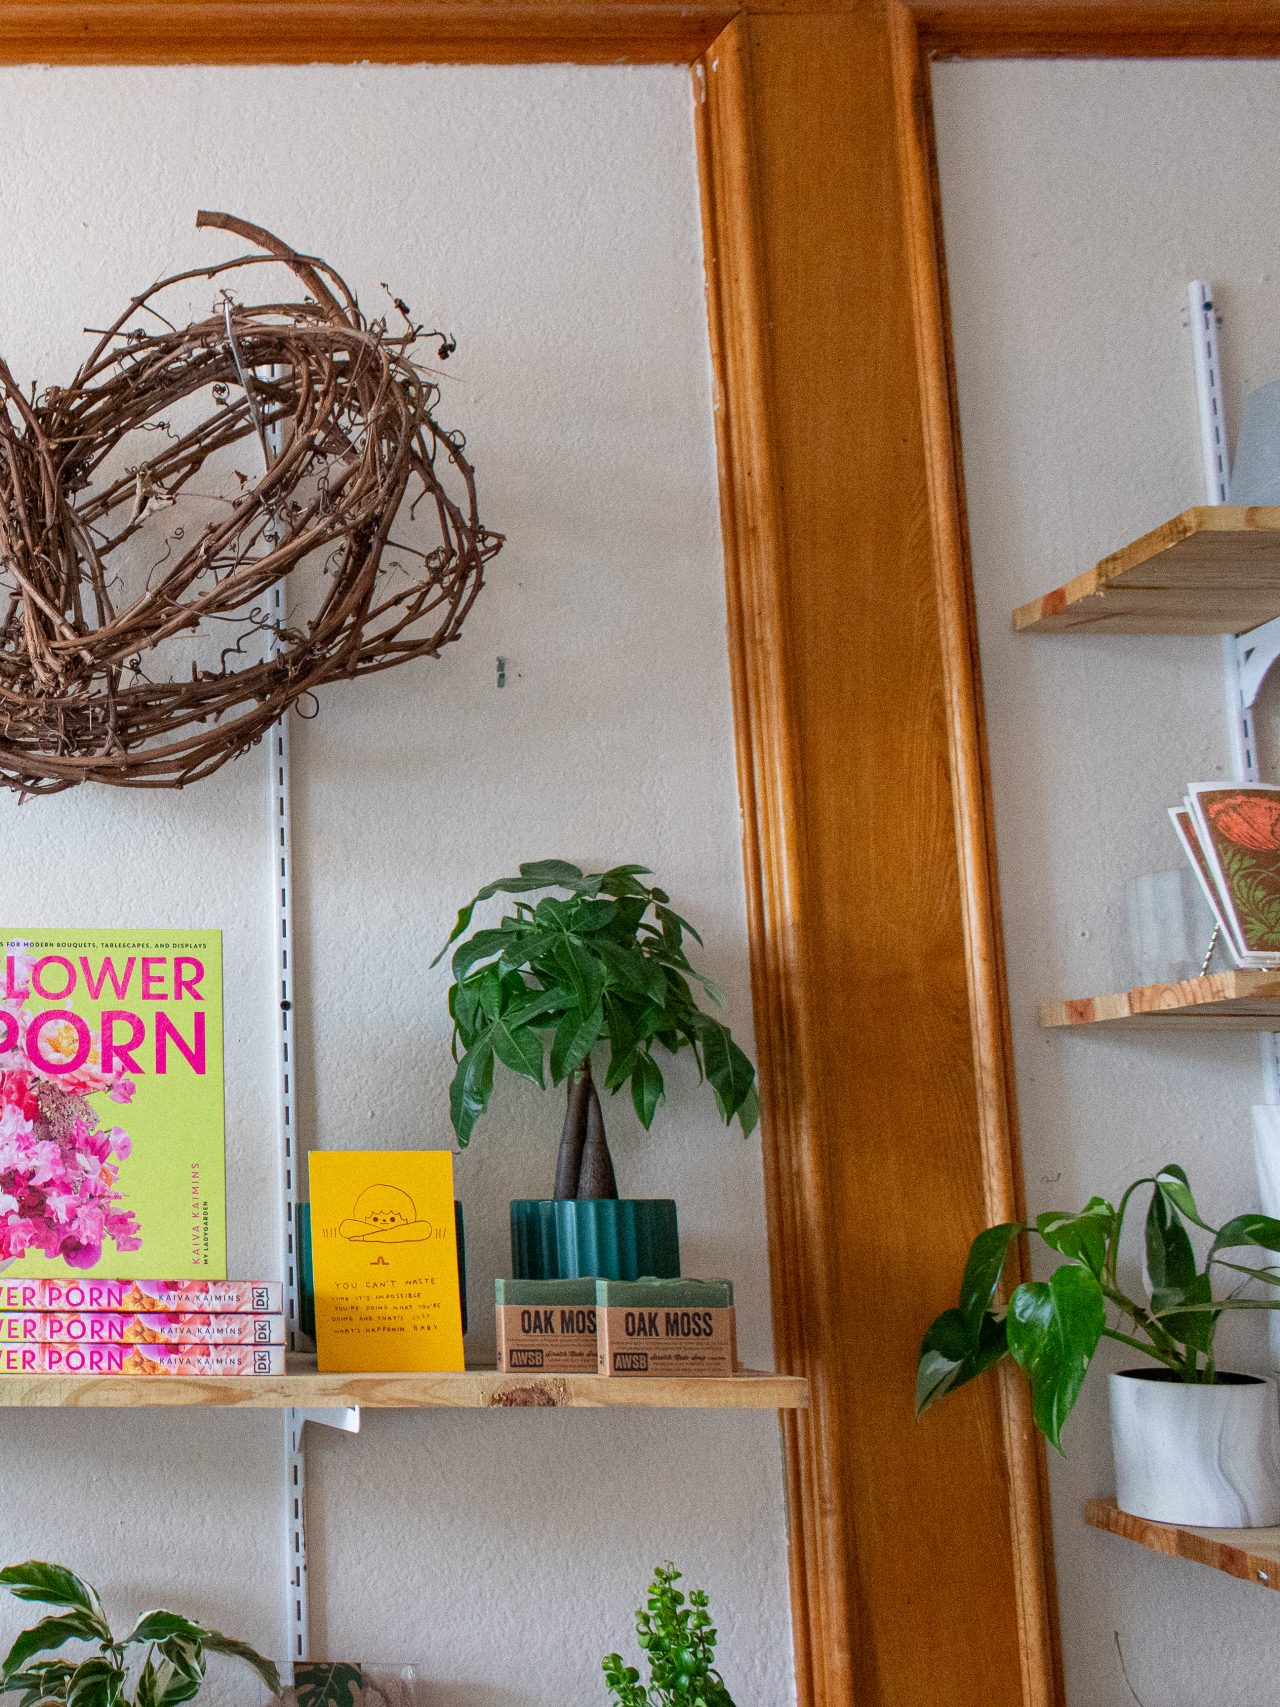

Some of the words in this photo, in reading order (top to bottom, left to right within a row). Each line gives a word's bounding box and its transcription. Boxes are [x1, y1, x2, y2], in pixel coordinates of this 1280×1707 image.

[23, 941, 55, 949] MODERN
[56, 942, 99, 950] BOUQUETS,
[100, 942, 153, 950] TABLESCAPES,
[154, 942, 171, 950] AND
[172, 942, 208, 950] DISPLAYS
[192, 1163, 200, 1219] KAIMINS
[192, 1225, 201, 1265] KAIVA
[203, 1254, 209, 1265] MY
[366, 1280, 397, 1288] CAN'T
[48, 1286, 123, 1307] PORN
[159, 1293, 191, 1302] KAIVA
[195, 1293, 241, 1302] KAIMINS
[256, 1290, 265, 1307] DK
[49, 1317, 124, 1339] PORN
[521, 1310, 554, 1334] OAK
[561, 1310, 596, 1334] MOS
[625, 1312, 659, 1336] OAK
[666, 1312, 713, 1337] MOSS
[160, 1326, 193, 1336] KAIVA
[197, 1326, 244, 1336] KAIMINS
[258, 1323, 267, 1341] DK
[47, 1349, 123, 1371] PORN
[159, 1357, 191, 1366] KAIVA
[197, 1357, 243, 1366] KAIMINS
[257, 1353, 267, 1370] DK
[511, 1351, 543, 1366] AWSB
[614, 1354, 647, 1370] AWSB
